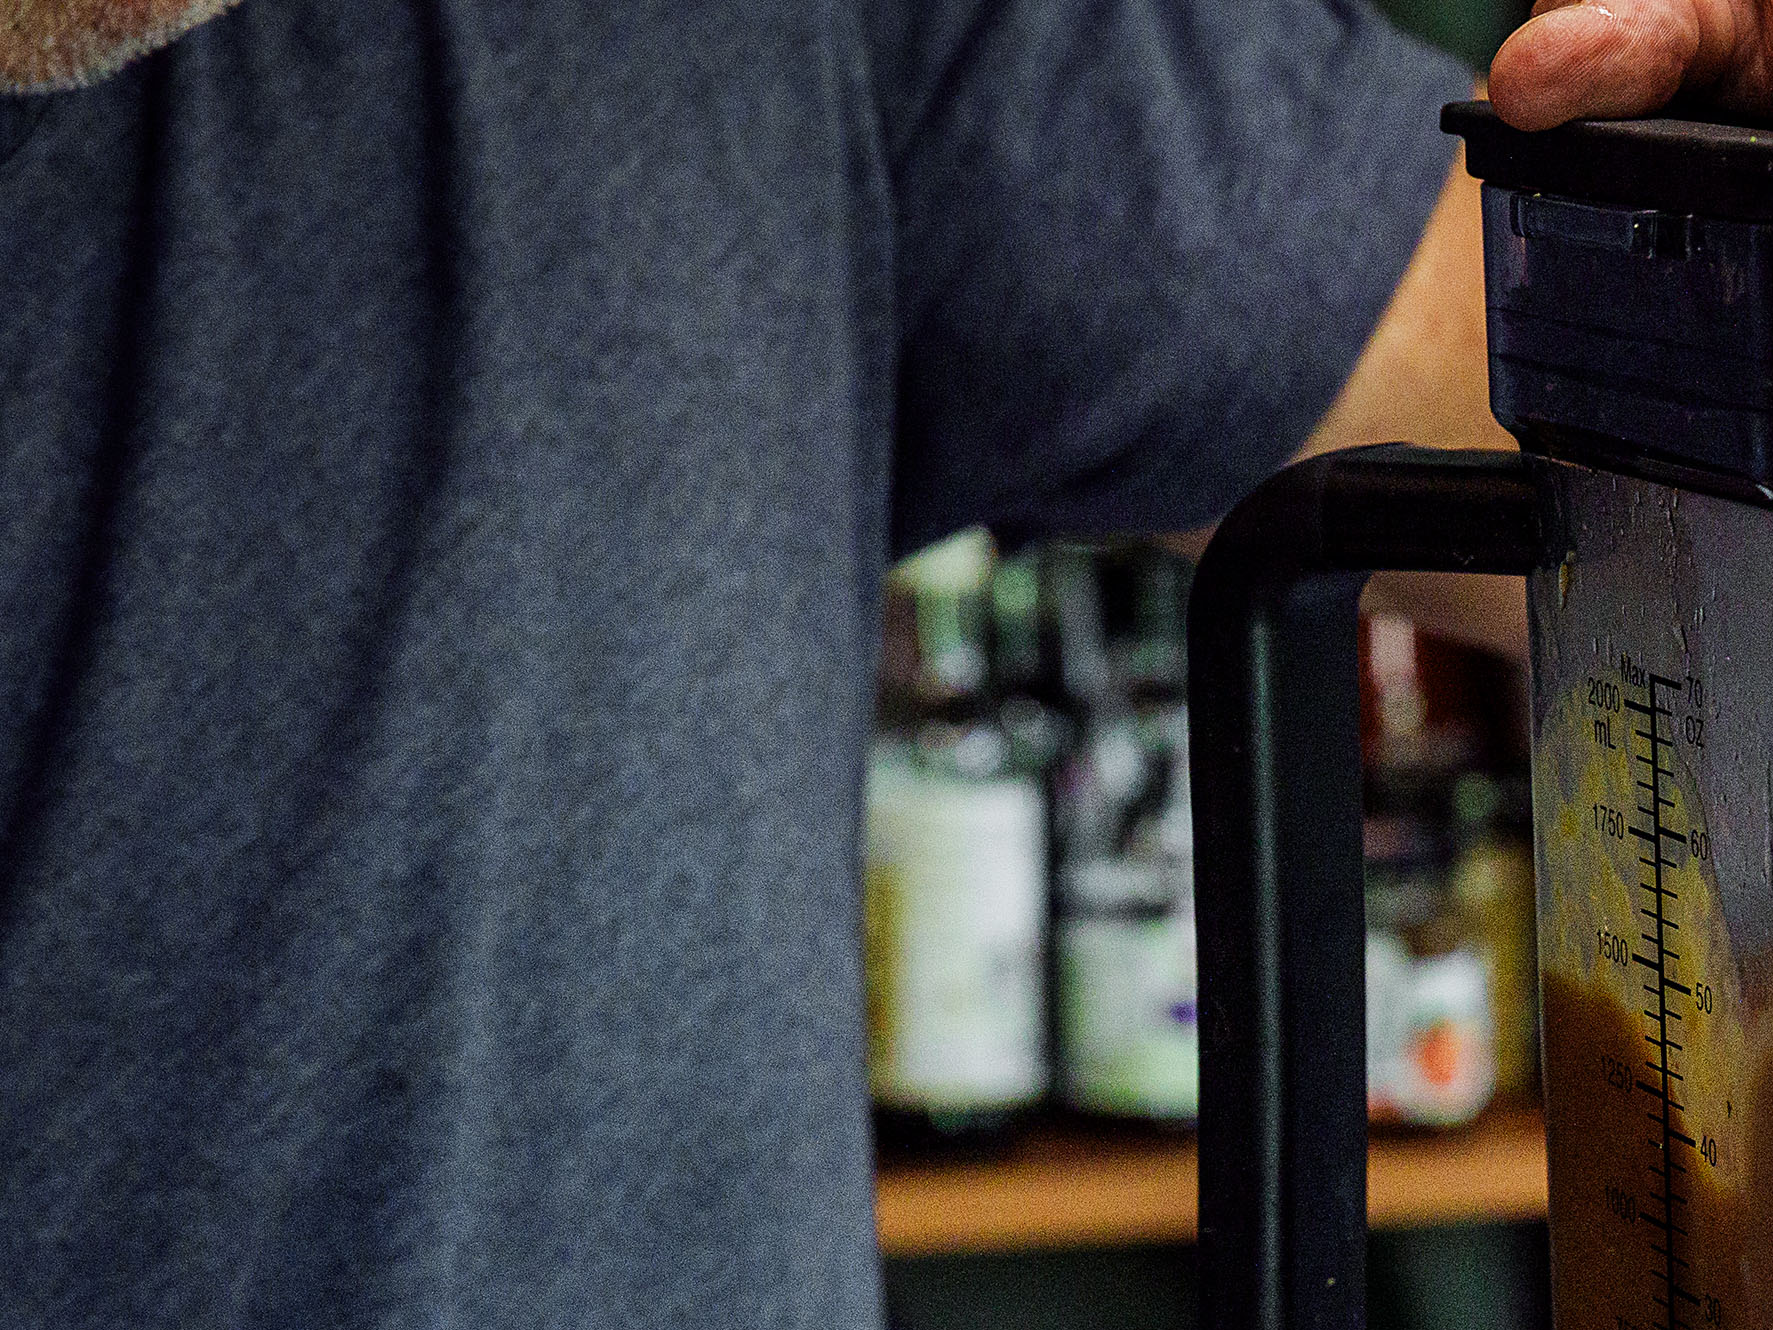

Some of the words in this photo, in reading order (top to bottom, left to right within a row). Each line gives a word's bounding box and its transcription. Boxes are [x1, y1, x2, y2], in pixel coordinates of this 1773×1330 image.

[1620, 654, 1646, 689] Max
[1588, 677, 1620, 713] 2000
[1686, 675, 1703, 709] 70
[1594, 716, 1617, 750] mL
[1593, 803, 1624, 839] 1750
[1691, 829, 1708, 861] 60
[1597, 929, 1628, 966] 1500
[1696, 982, 1713, 1014] 50
[1602, 1055, 1633, 1093] 1250
[1700, 1135, 1717, 1166] 40
[1605, 1185, 1636, 1223] 1000
[1705, 1293, 1721, 1327] 30
